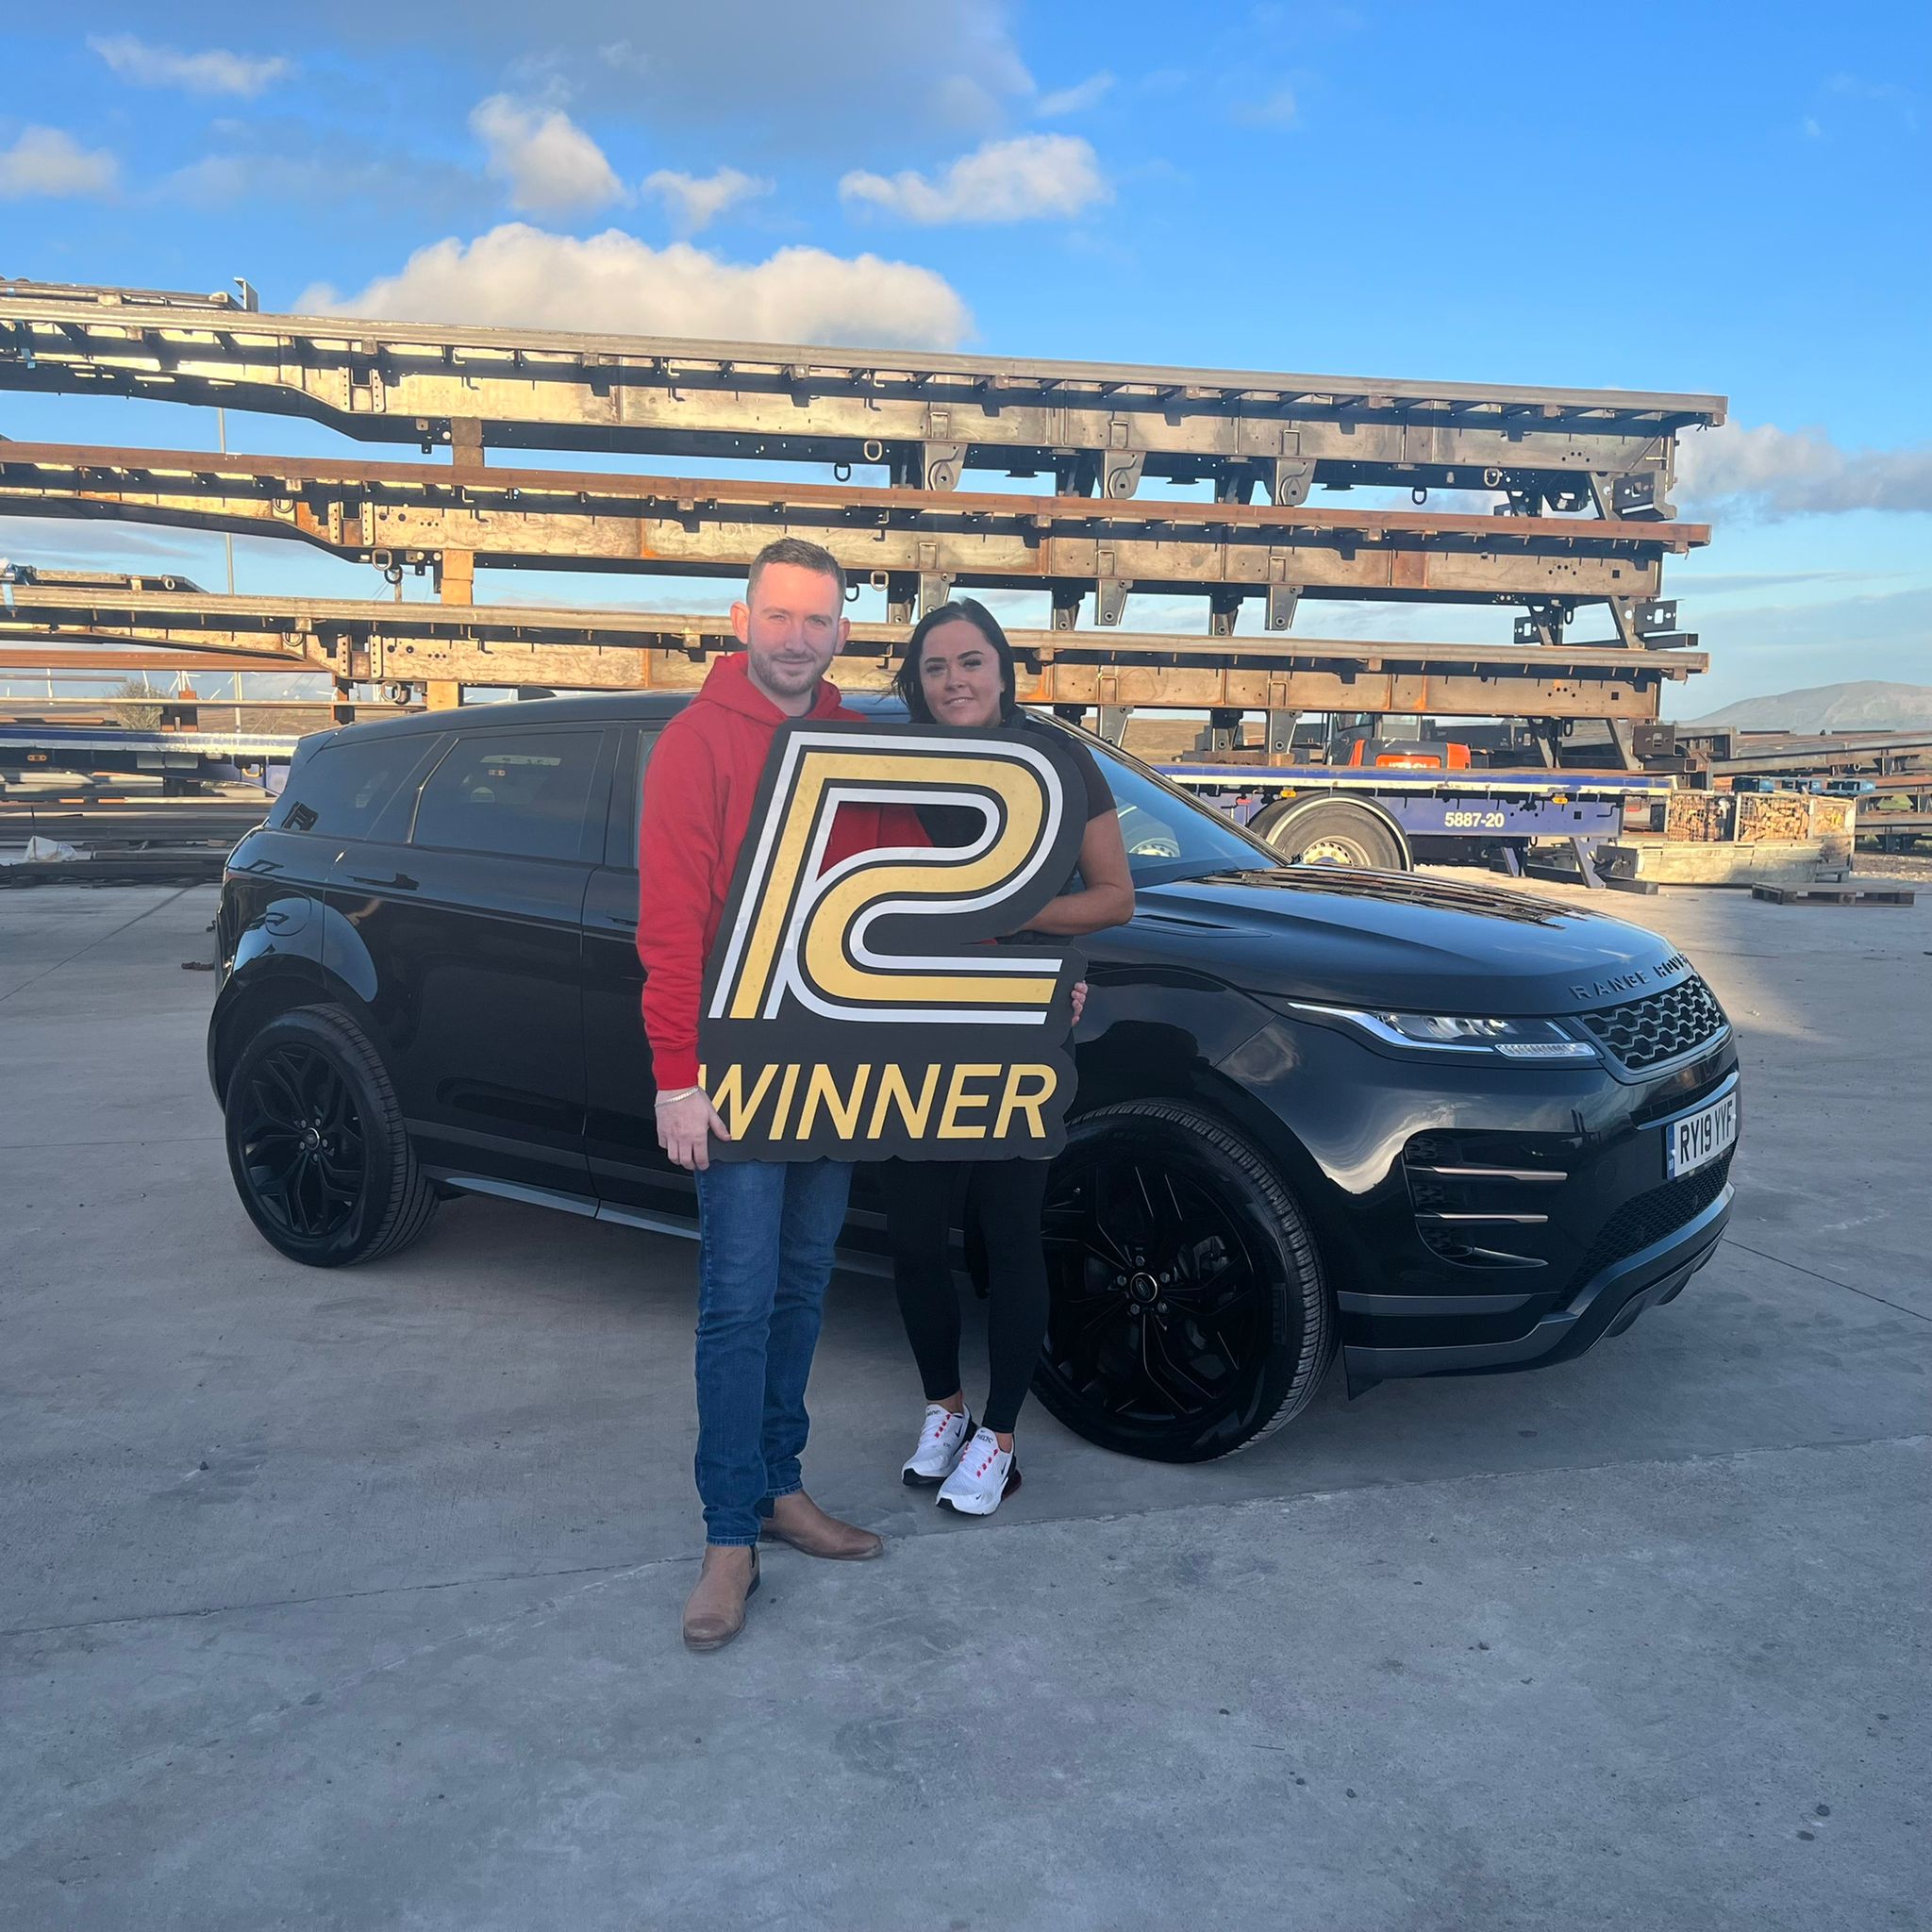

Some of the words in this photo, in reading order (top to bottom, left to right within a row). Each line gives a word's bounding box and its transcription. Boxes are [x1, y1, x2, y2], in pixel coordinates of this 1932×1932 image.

[1444, 811, 1505, 828] 5887-20
[1568, 970, 1651, 1000] RANGE
[1652, 952, 1689, 979] ROVE
[697, 1063, 1058, 1141] WINNER
[1680, 1113, 1712, 1165] RY19
[1714, 1099, 1733, 1146] YYF
